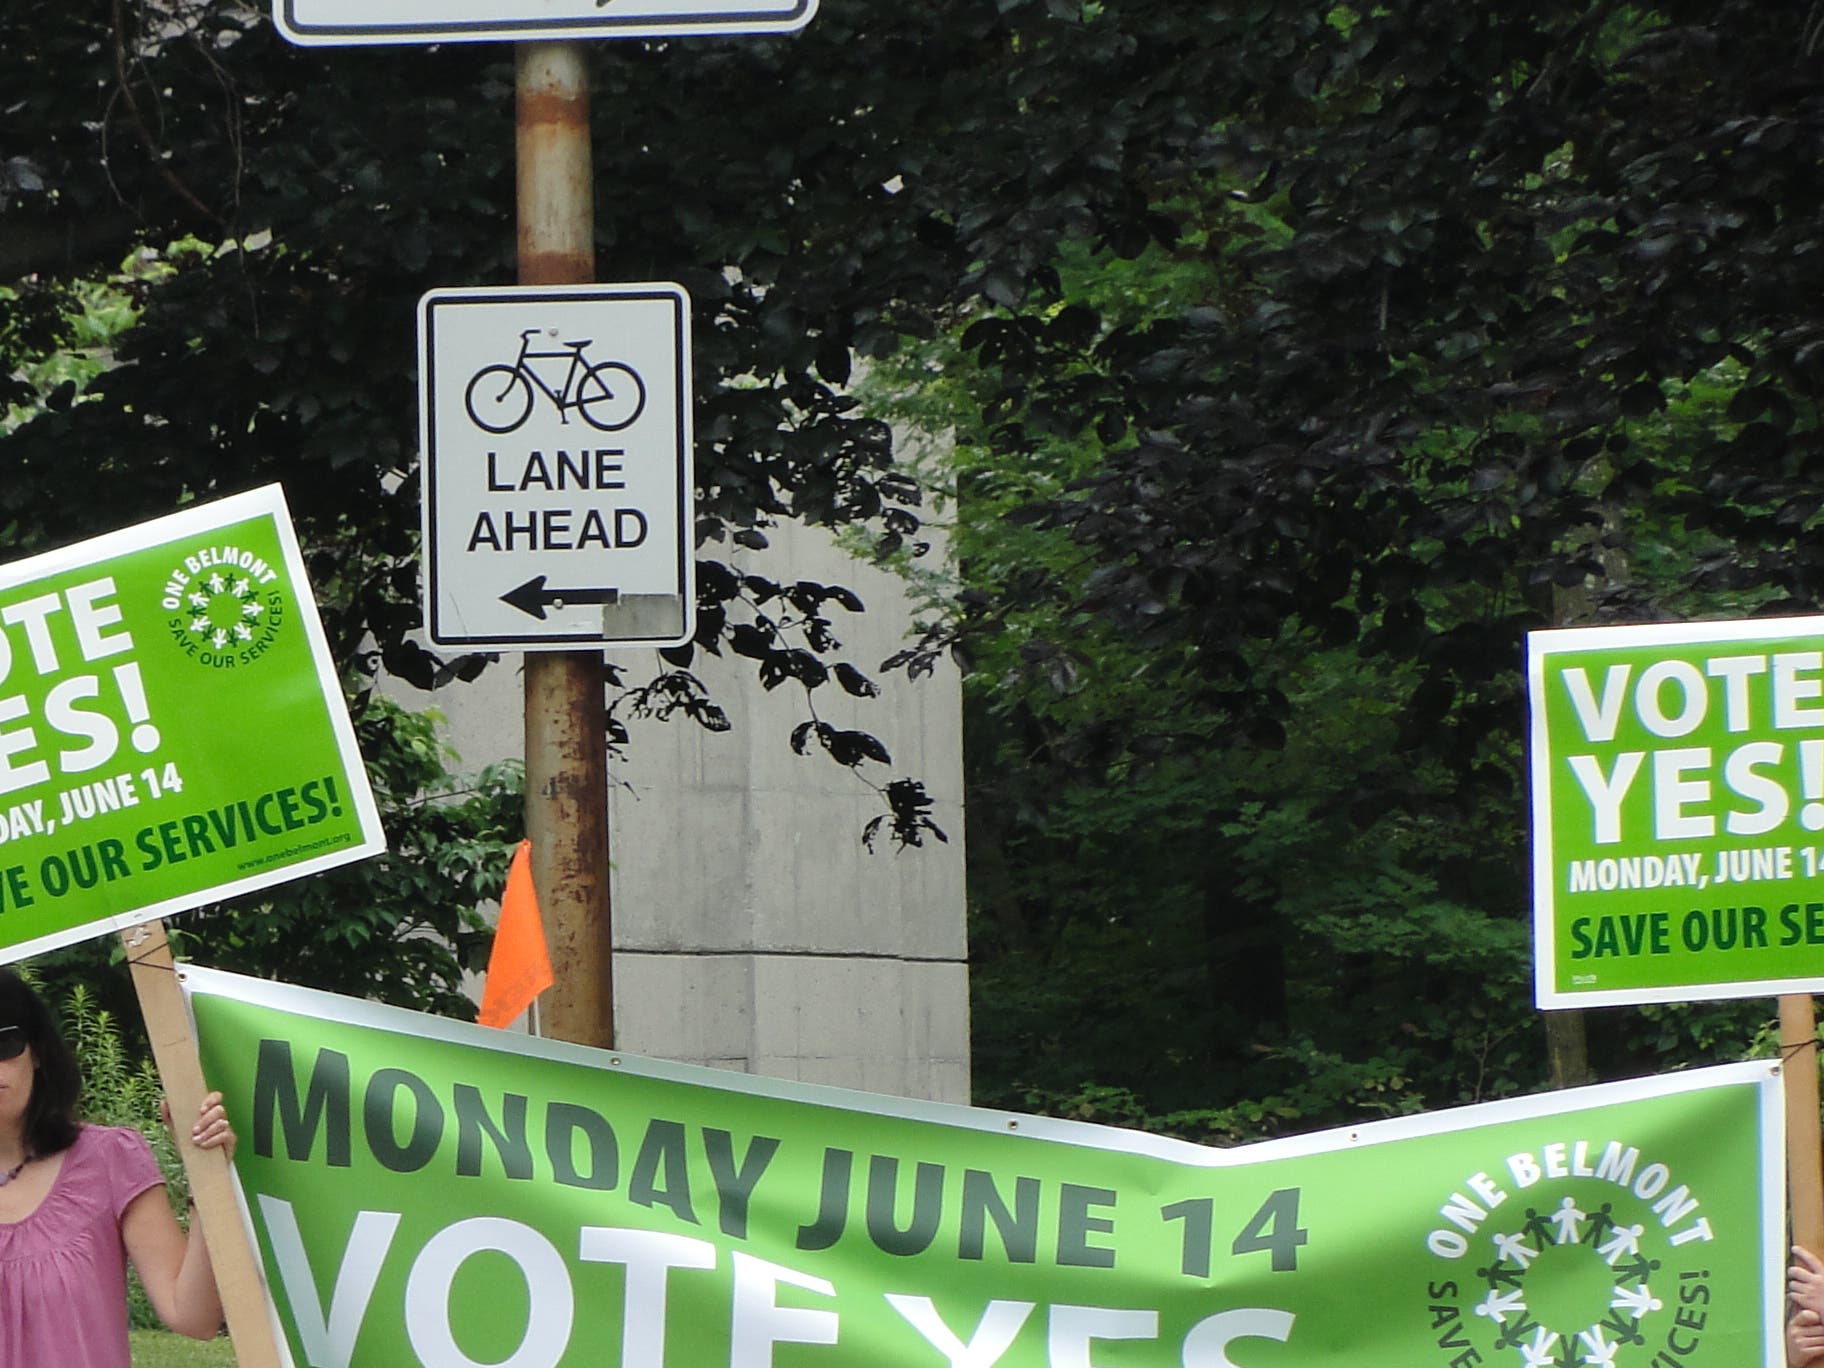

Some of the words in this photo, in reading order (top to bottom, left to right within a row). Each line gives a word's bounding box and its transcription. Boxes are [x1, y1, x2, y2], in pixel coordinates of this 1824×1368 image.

[487, 449, 626, 492] LANE
[467, 508, 649, 551] AHEAD
[162, 568, 190, 610] ONE
[184, 546, 278, 584] BELMONT
[168, 618, 199, 657] SAVE
[200, 652, 235, 668] OUR
[240, 590, 283, 665] SERVICES!
[1561, 651, 1824, 743] VOTE
[60, 775, 139, 827] JUNE
[142, 762, 183, 800] 14
[1567, 739, 1824, 844] YES!
[41, 839, 128, 898] OUR
[144, 776, 343, 871] SERVICES!
[1568, 852, 1709, 893] MONDAY,
[1714, 846, 1793, 884] JUNE
[1571, 912, 1670, 960] SAVE
[1682, 906, 1768, 953] OUR
[253, 1038, 781, 1240] MONDAY
[796, 1147, 1117, 1270] JUNE
[1161, 1187, 1308, 1279] 14
[1427, 1172, 1507, 1259] ONE
[1506, 1140, 1714, 1246] BELMONT
